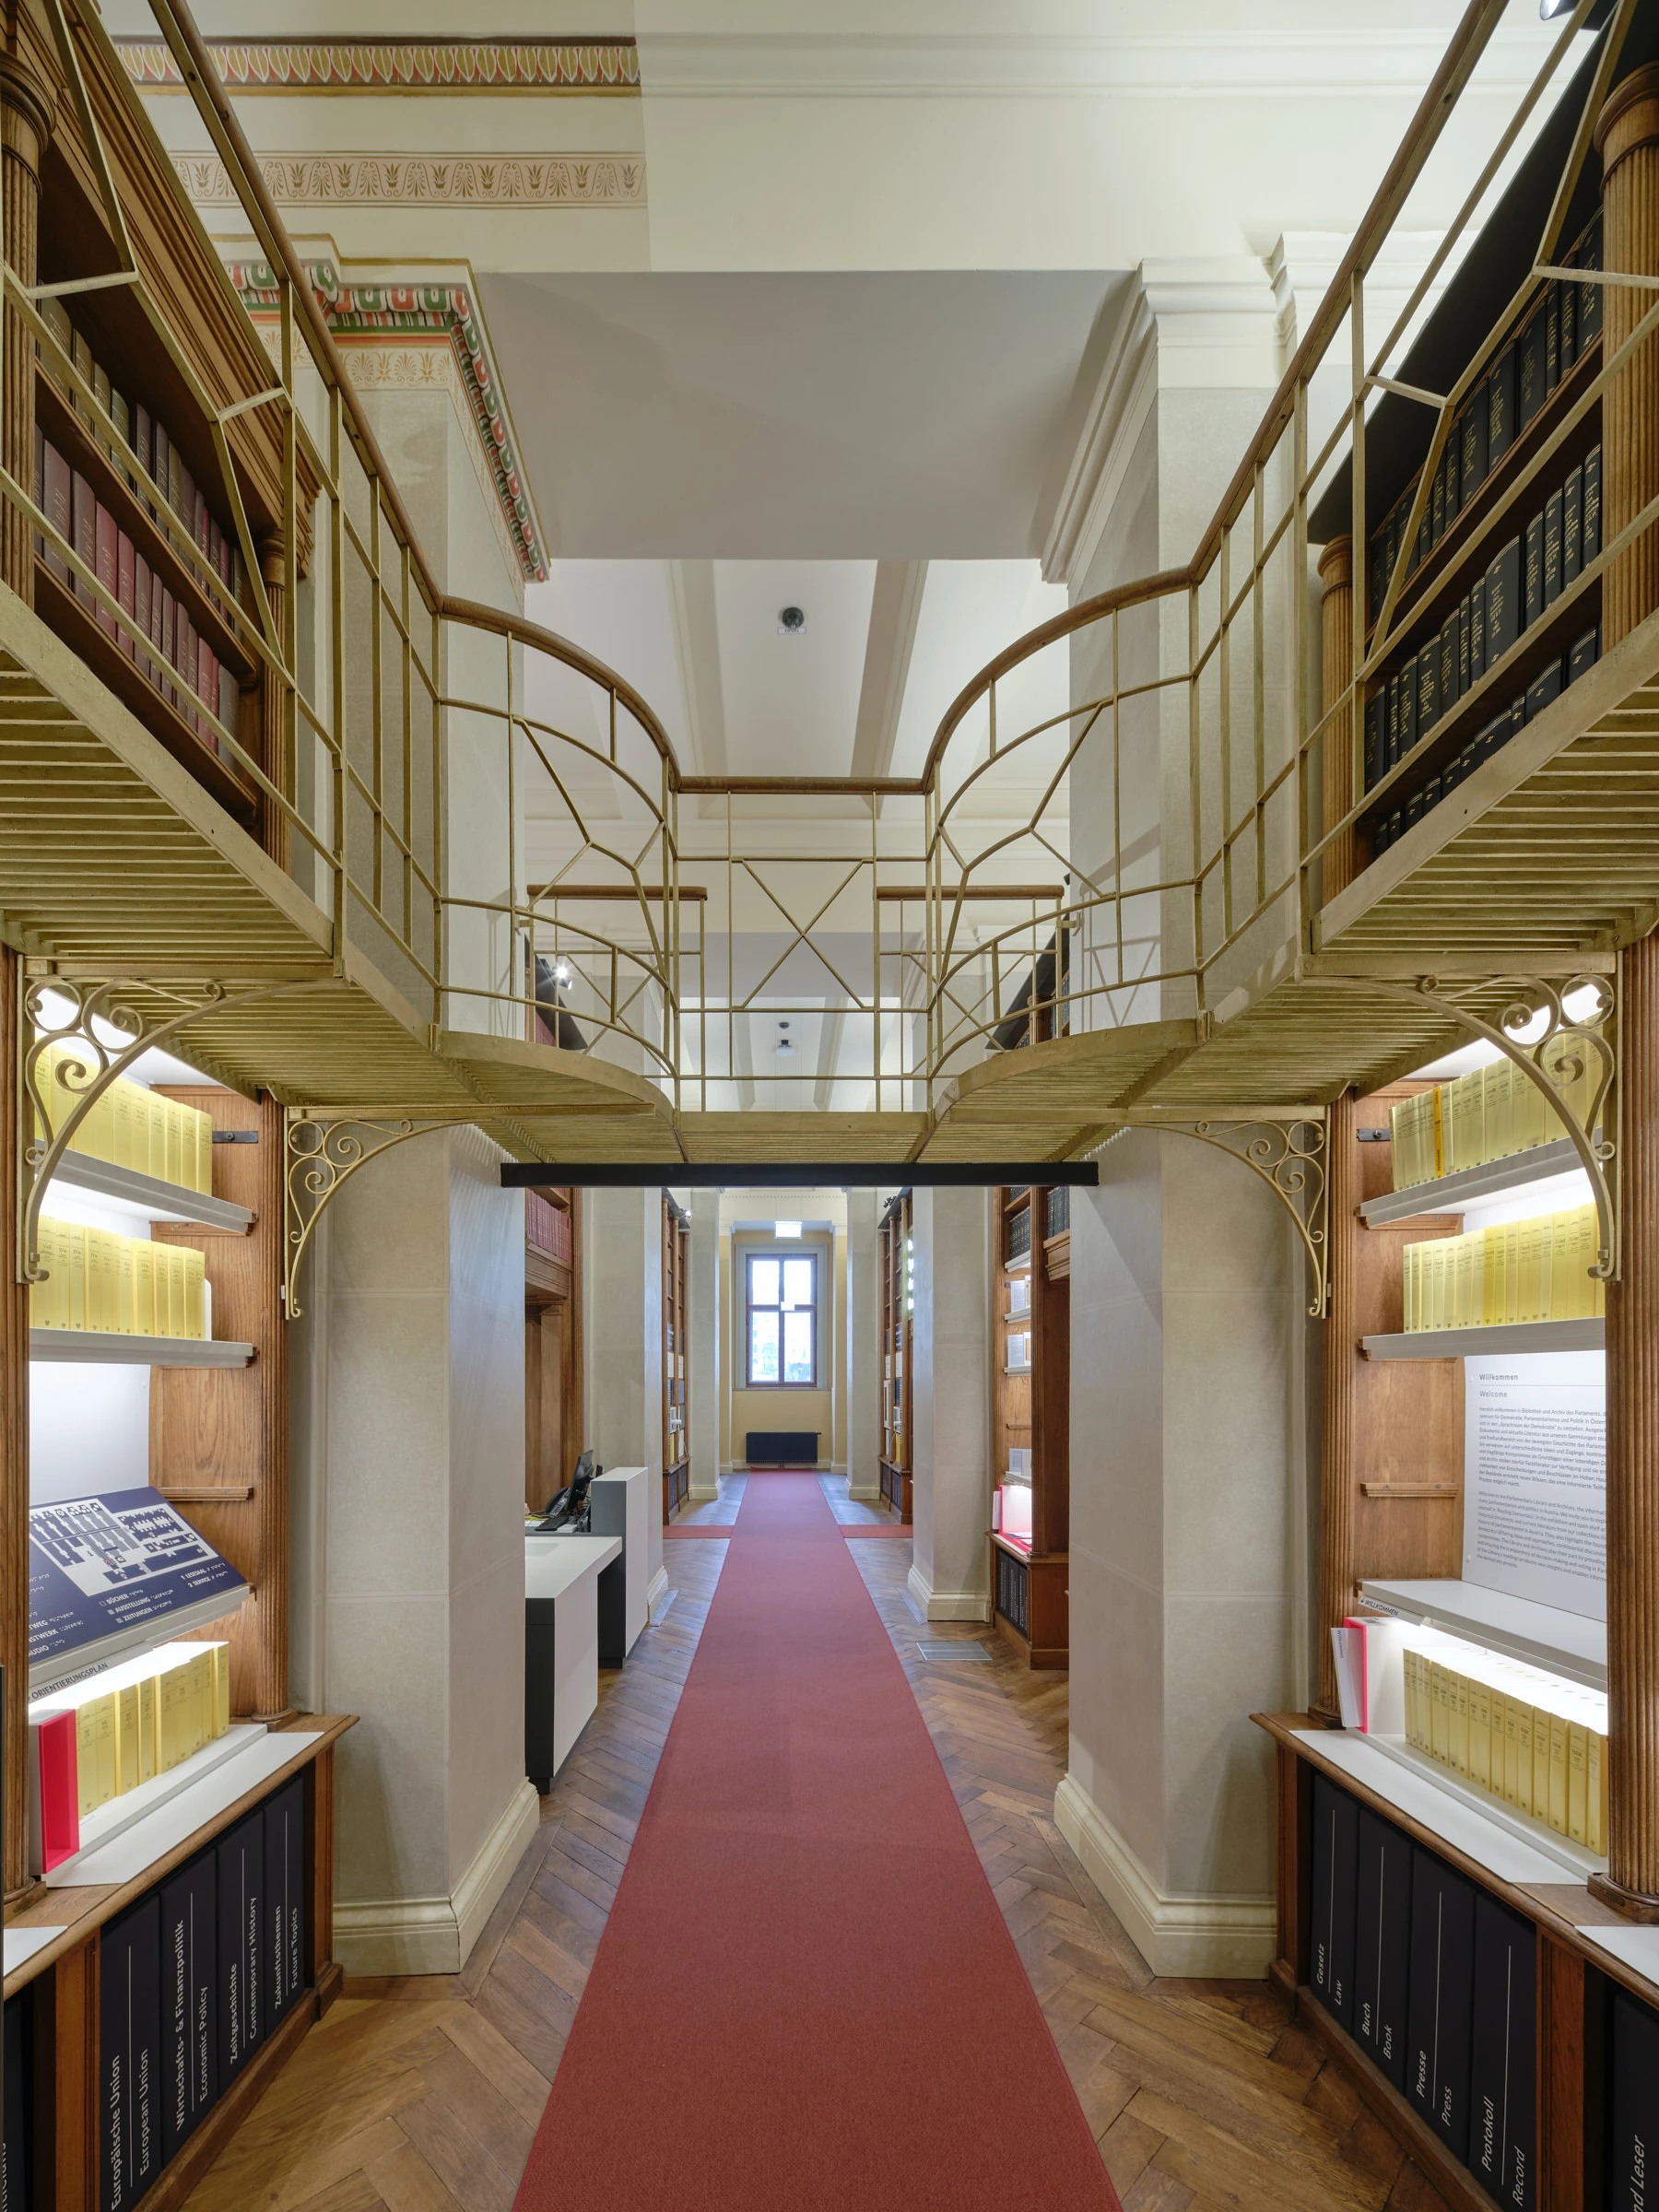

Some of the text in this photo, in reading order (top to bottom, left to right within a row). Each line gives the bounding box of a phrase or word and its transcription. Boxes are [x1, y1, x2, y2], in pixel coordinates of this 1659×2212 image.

[106, 1593, 129, 1605] BÜCHER
[193, 1576, 211, 1586] SERVICE
[114, 1596, 151, 1613] AUSSTELLUNG
[123, 1606, 153, 1621] ZEITUNGEN
[1364, 1599, 1399, 1617] WILLKOMMEN
[31, 1662, 109, 1699] ORIENTIERUNGSPLAN
[249, 1897, 258, 2040] Contemporary History
[1316, 1943, 1324, 1984] Gesetz
[174, 1919, 185, 2131] Wirtschafts- & Finanzpolitik
[229, 1963, 239, 2065] Zeitgeschichte
[1361, 2002, 1371, 2036] Buch
[198, 1986, 209, 2101] Economic Policy
[1382, 2025, 1392, 2060] Book
[1416, 2050, 1427, 2098] Presse
[138, 2048, 150, 2176] European Union
[1441, 2086, 1452, 2126] Press
[110, 2054, 123, 2211] Europäische Union
[1481, 2096, 1494, 2171] Protokoll
[1512, 2145, 1525, 2206] Record
[1630, 2134, 1645, 2212] nd Leser
